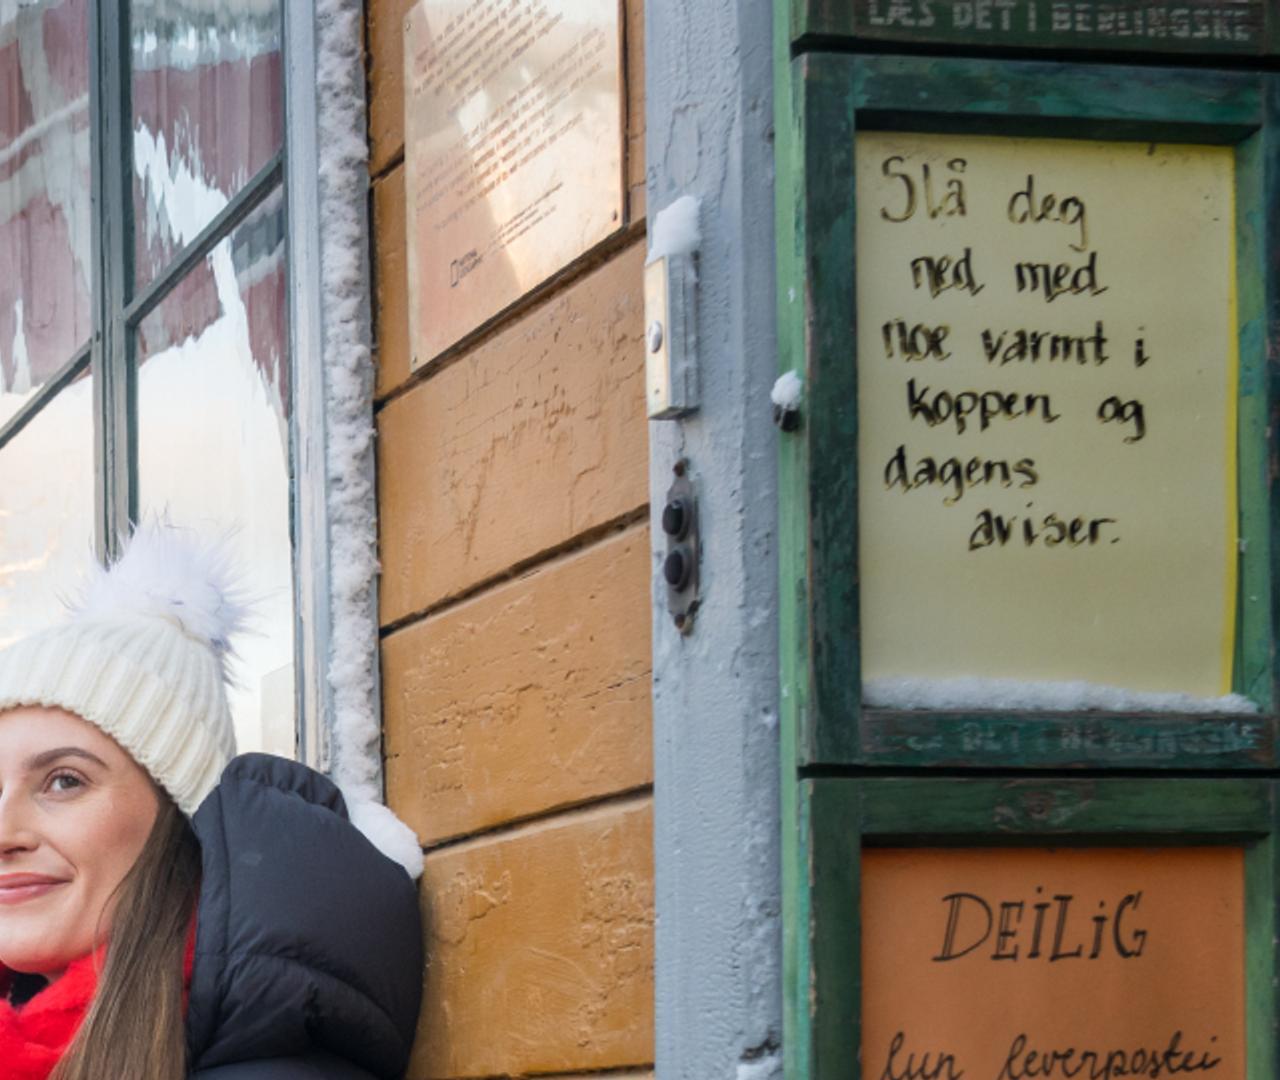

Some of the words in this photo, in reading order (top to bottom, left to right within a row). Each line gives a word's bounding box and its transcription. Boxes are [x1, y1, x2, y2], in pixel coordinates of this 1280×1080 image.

[953, 1, 1010, 30] DET
[1028, 2, 1037, 31] I
[880, 156, 967, 222] Slå
[1007, 174, 1088, 252] deg
[910, 247, 984, 299] ned
[1015, 251, 1108, 303] med
[882, 318, 952, 361] noe
[981, 320, 1109, 366] varmt
[1134, 326, 1150, 368] i
[907, 377, 1061, 435] koppen
[1097, 396, 1145, 444] og
[883, 444, 1039, 506] dagens
[968, 502, 1120, 551] aviser.
